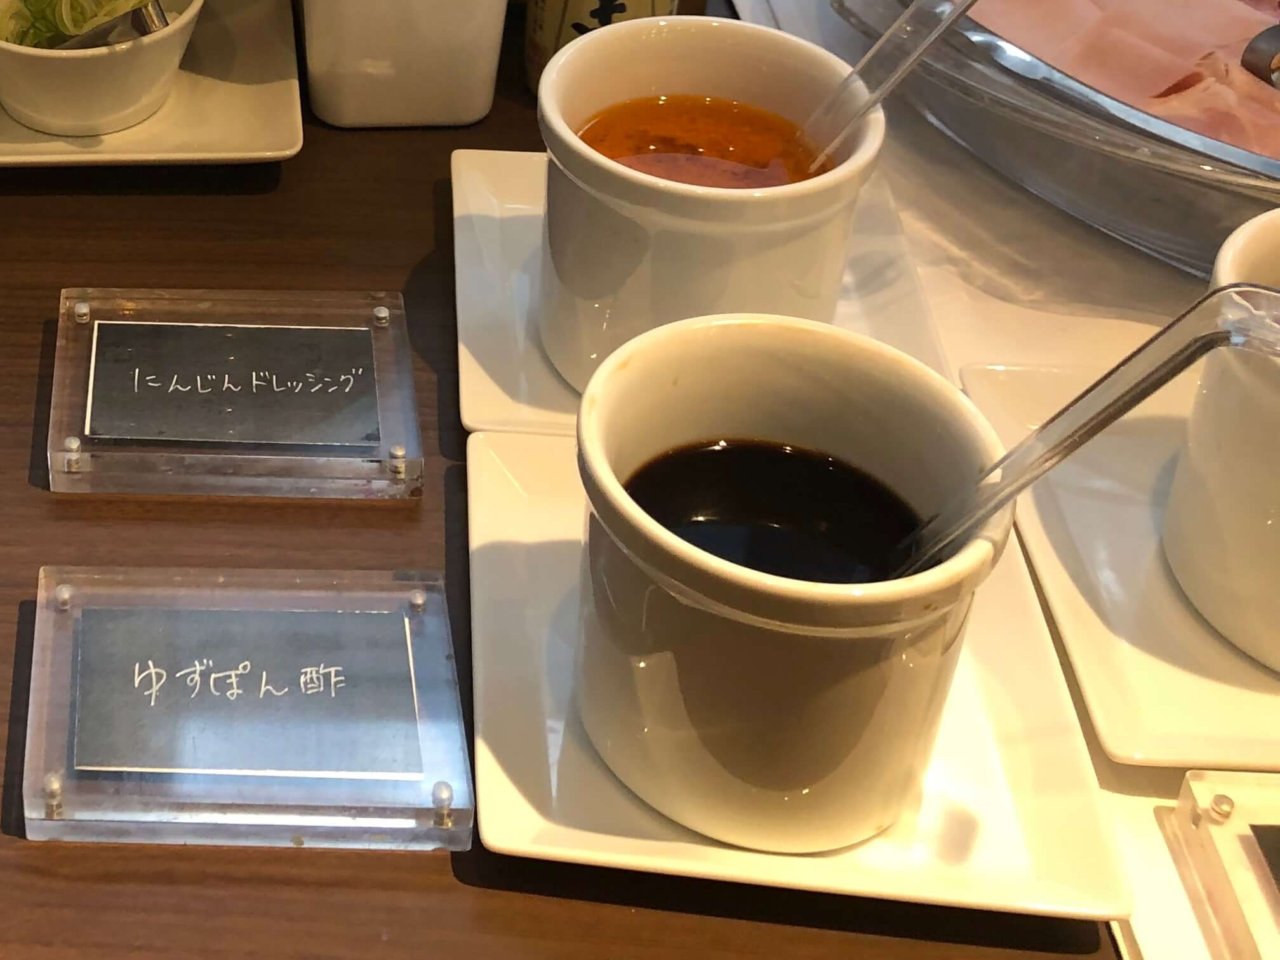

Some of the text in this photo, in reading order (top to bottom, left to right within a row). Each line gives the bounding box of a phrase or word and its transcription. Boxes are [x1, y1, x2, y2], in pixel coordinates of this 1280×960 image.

[132, 367, 365, 395] にんじんドレッシング
[133, 659, 346, 707] ゆずぽん酢
